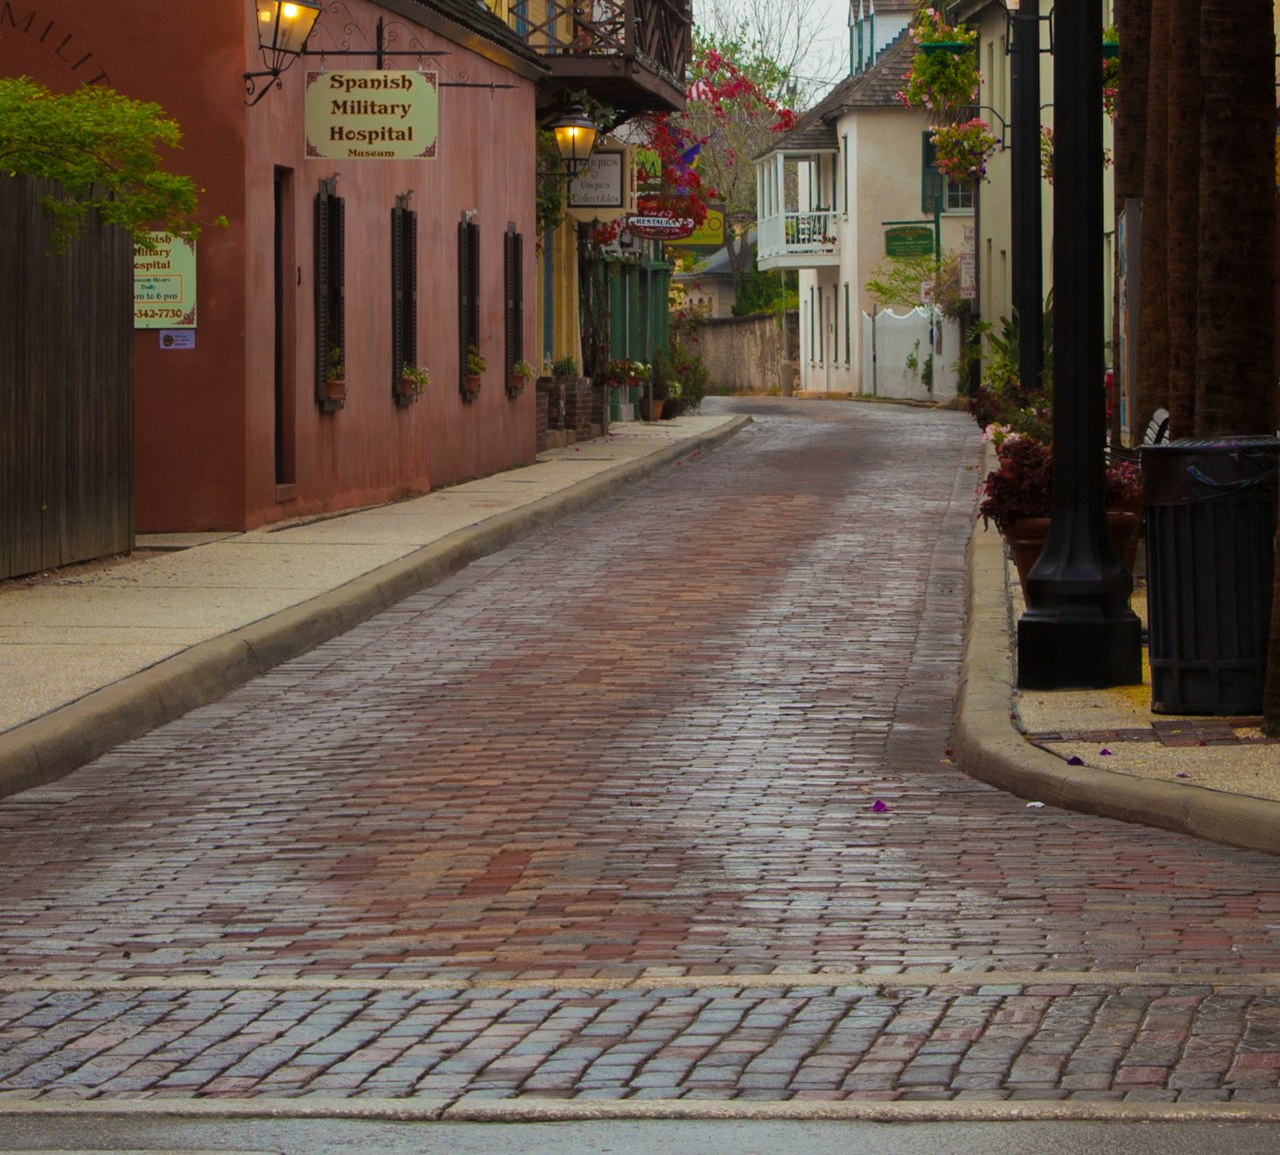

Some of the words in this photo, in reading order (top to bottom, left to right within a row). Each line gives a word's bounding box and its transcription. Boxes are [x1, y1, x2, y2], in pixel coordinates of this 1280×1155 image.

[329, 74, 413, 93] Spanish
[330, 99, 412, 119] Military
[329, 126, 413, 145] Hospital
[347, 148, 395, 158] Museum
[573, 194, 619, 202] Collectibles
[133, 260, 171, 271] ospital
